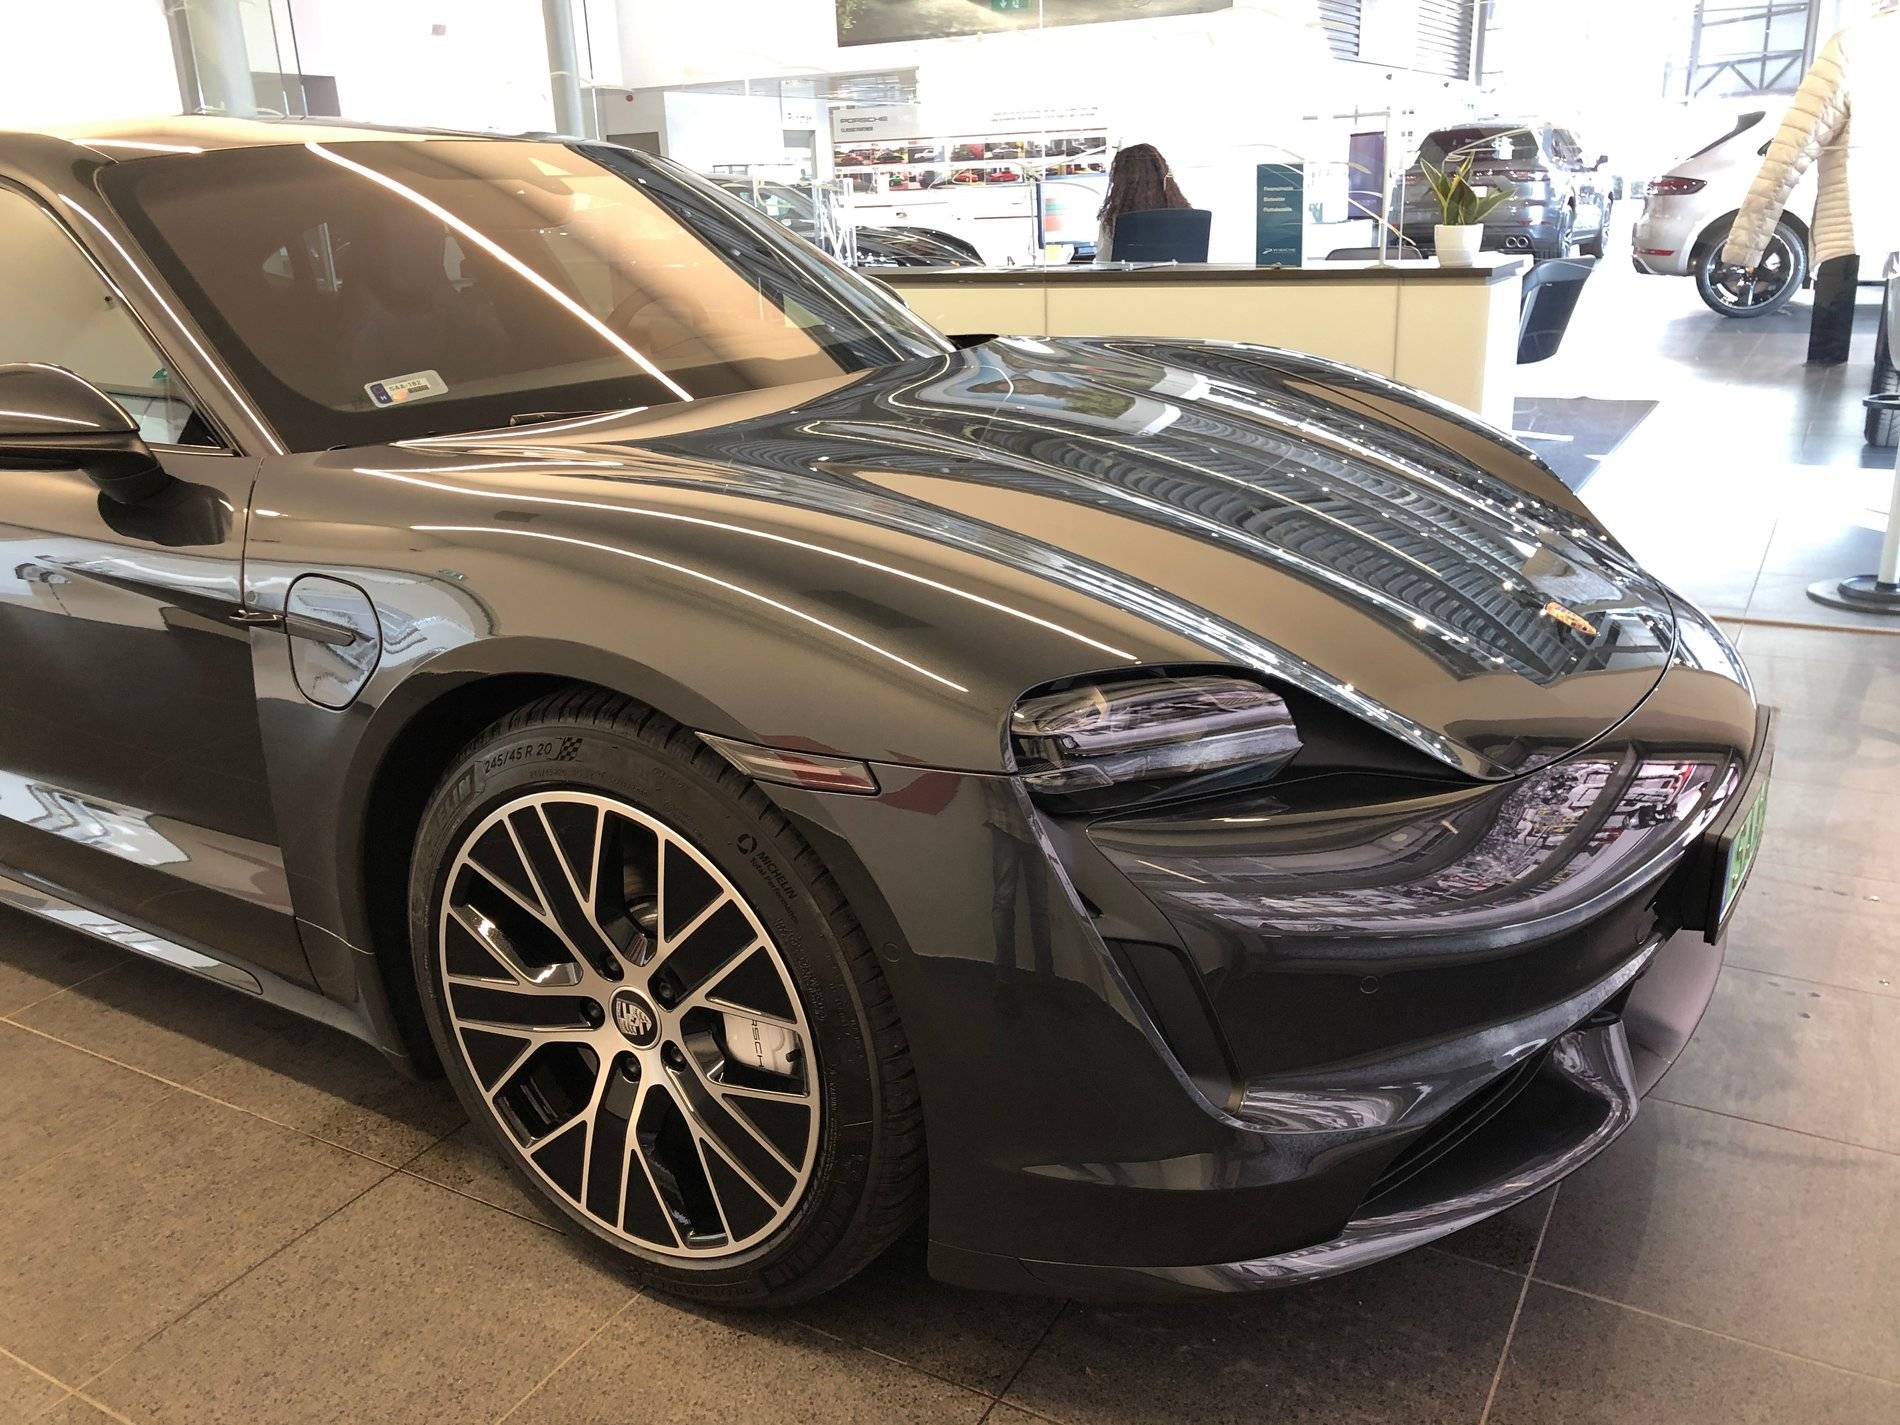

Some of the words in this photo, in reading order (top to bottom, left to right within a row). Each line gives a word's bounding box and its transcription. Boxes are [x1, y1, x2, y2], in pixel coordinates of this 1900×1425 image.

[484, 747, 522, 774] 245/45
[525, 744, 533, 757] R
[536, 742, 553, 756] 20
[756, 850, 797, 900] MICHELIN
[751, 1019, 764, 1067] RSCH
